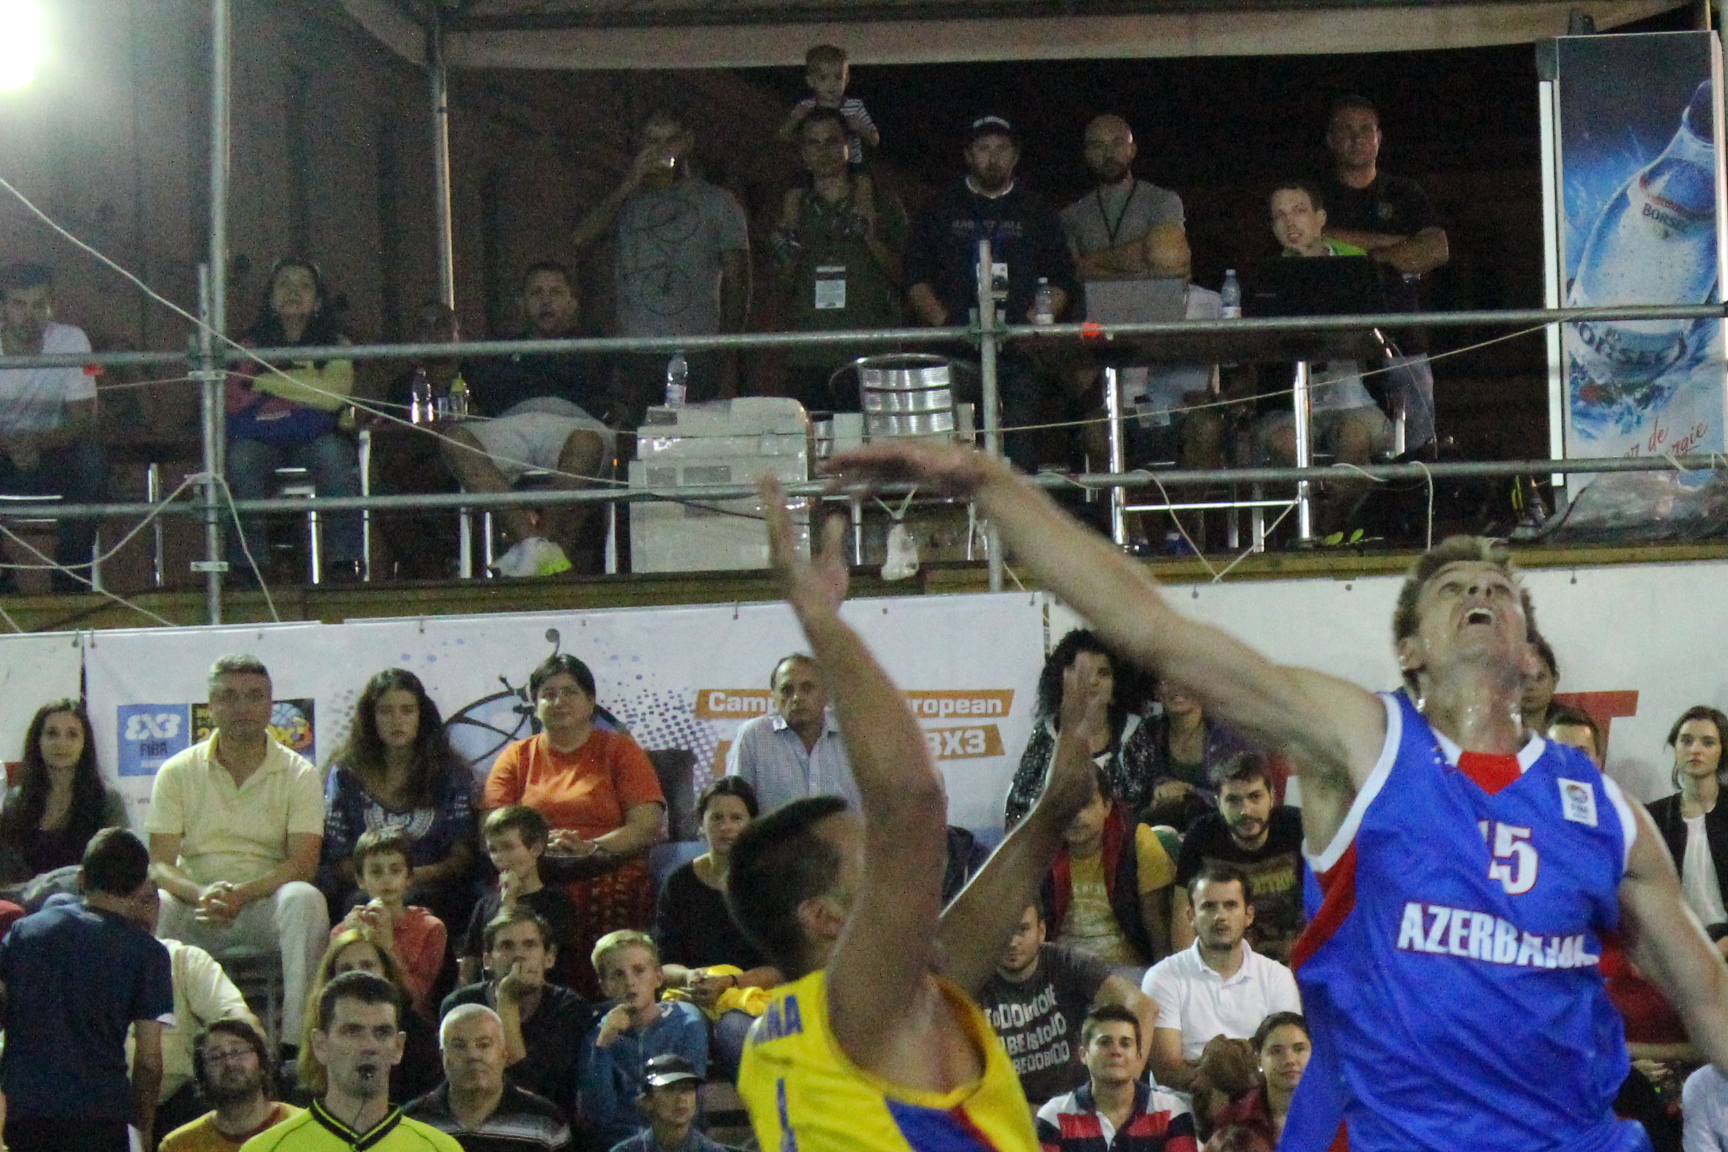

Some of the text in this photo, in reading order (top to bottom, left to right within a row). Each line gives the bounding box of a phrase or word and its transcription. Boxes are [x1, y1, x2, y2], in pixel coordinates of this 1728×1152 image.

[1648, 416, 1669, 453] de
[708, 691, 1002, 719] Camp ropean
